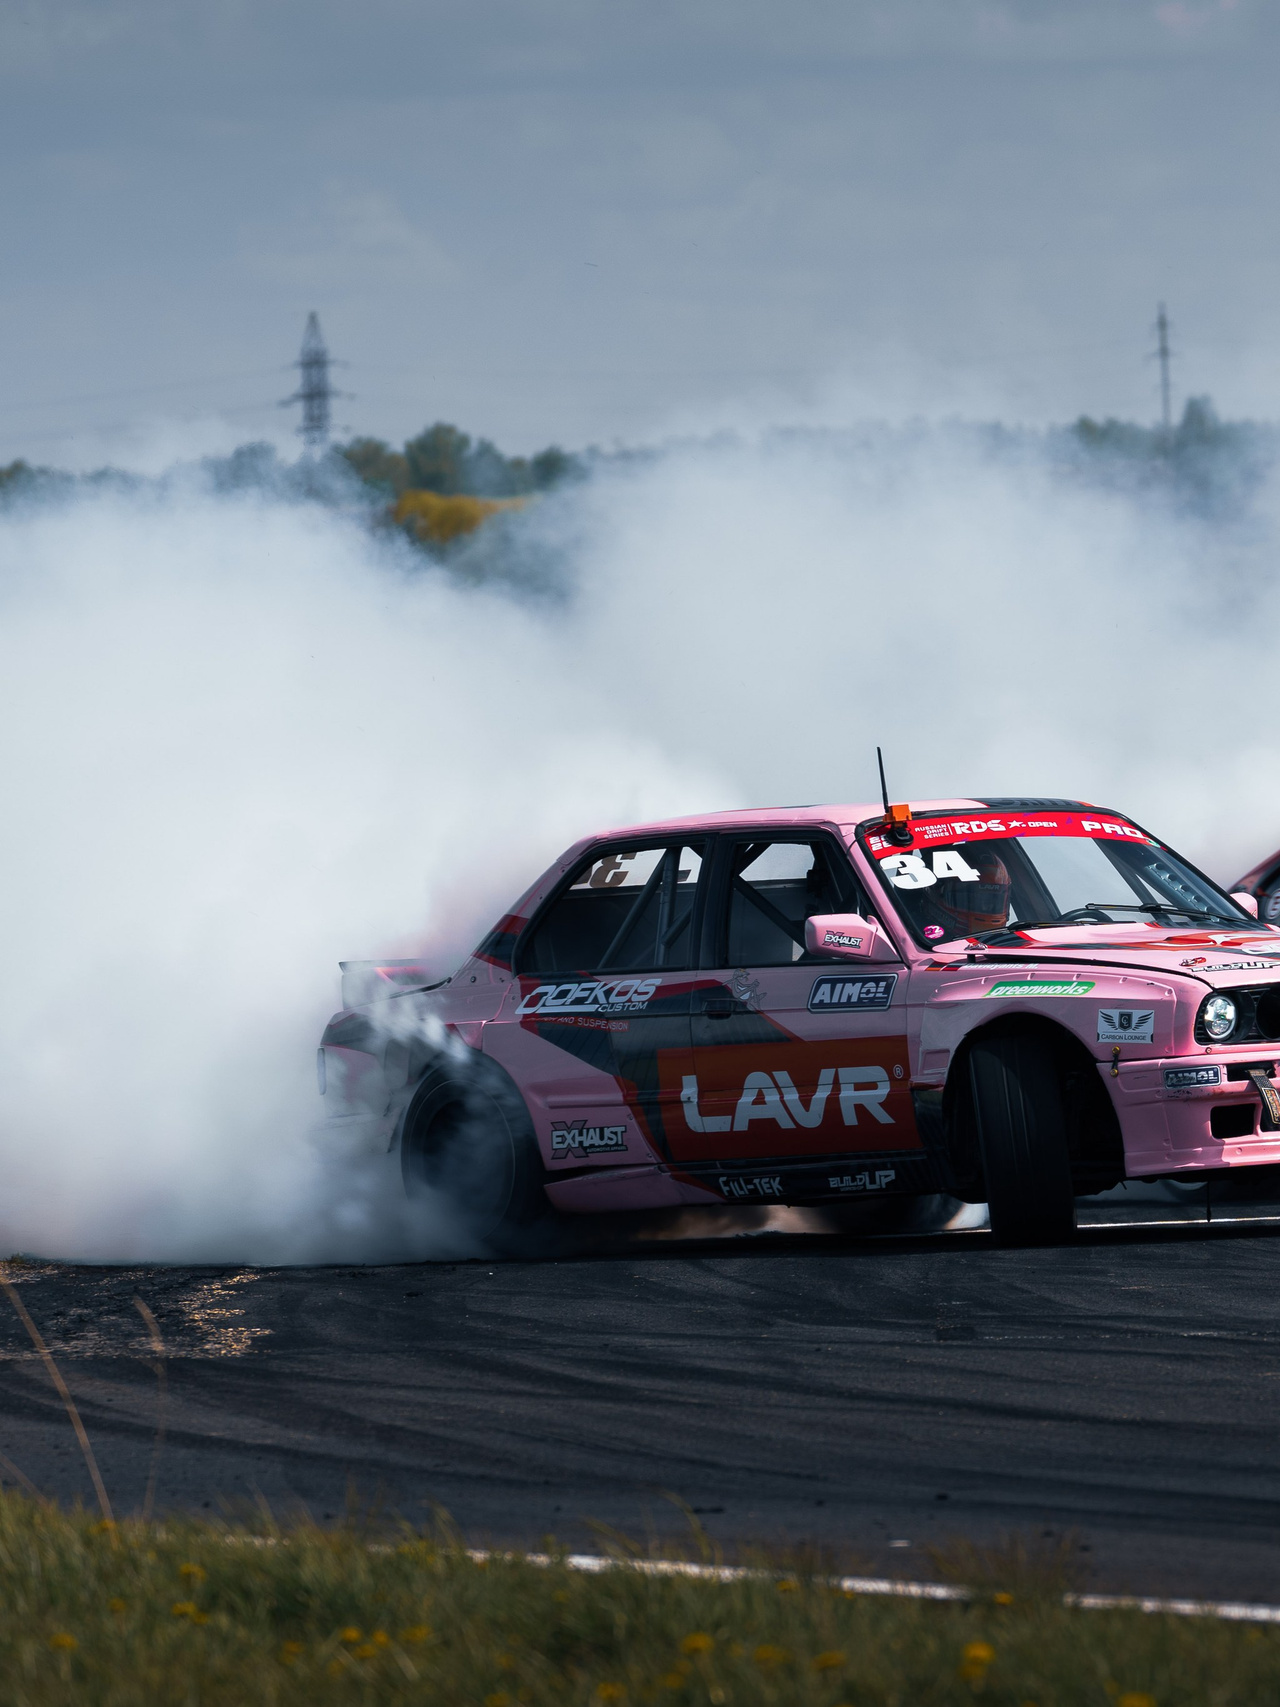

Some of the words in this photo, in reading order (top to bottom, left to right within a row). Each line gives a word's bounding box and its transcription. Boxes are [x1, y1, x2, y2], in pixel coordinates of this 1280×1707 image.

[914, 824, 947, 832] RUSSIAN
[950, 820, 1006, 835] RDS
[1080, 820, 1145, 839] PRO
[880, 851, 981, 889] 34
[822, 930, 862, 948] EXHAUST
[812, 982, 888, 1003] AIMOL
[990, 982, 1087, 996] greenworks
[598, 1001, 648, 1012] CUSTOM
[577, 1018, 628, 1031] SUSPENSION
[680, 1066, 896, 1133] LAVR
[551, 1122, 626, 1155] EXHAUST
[719, 1176, 784, 1198] FILI-TEK
